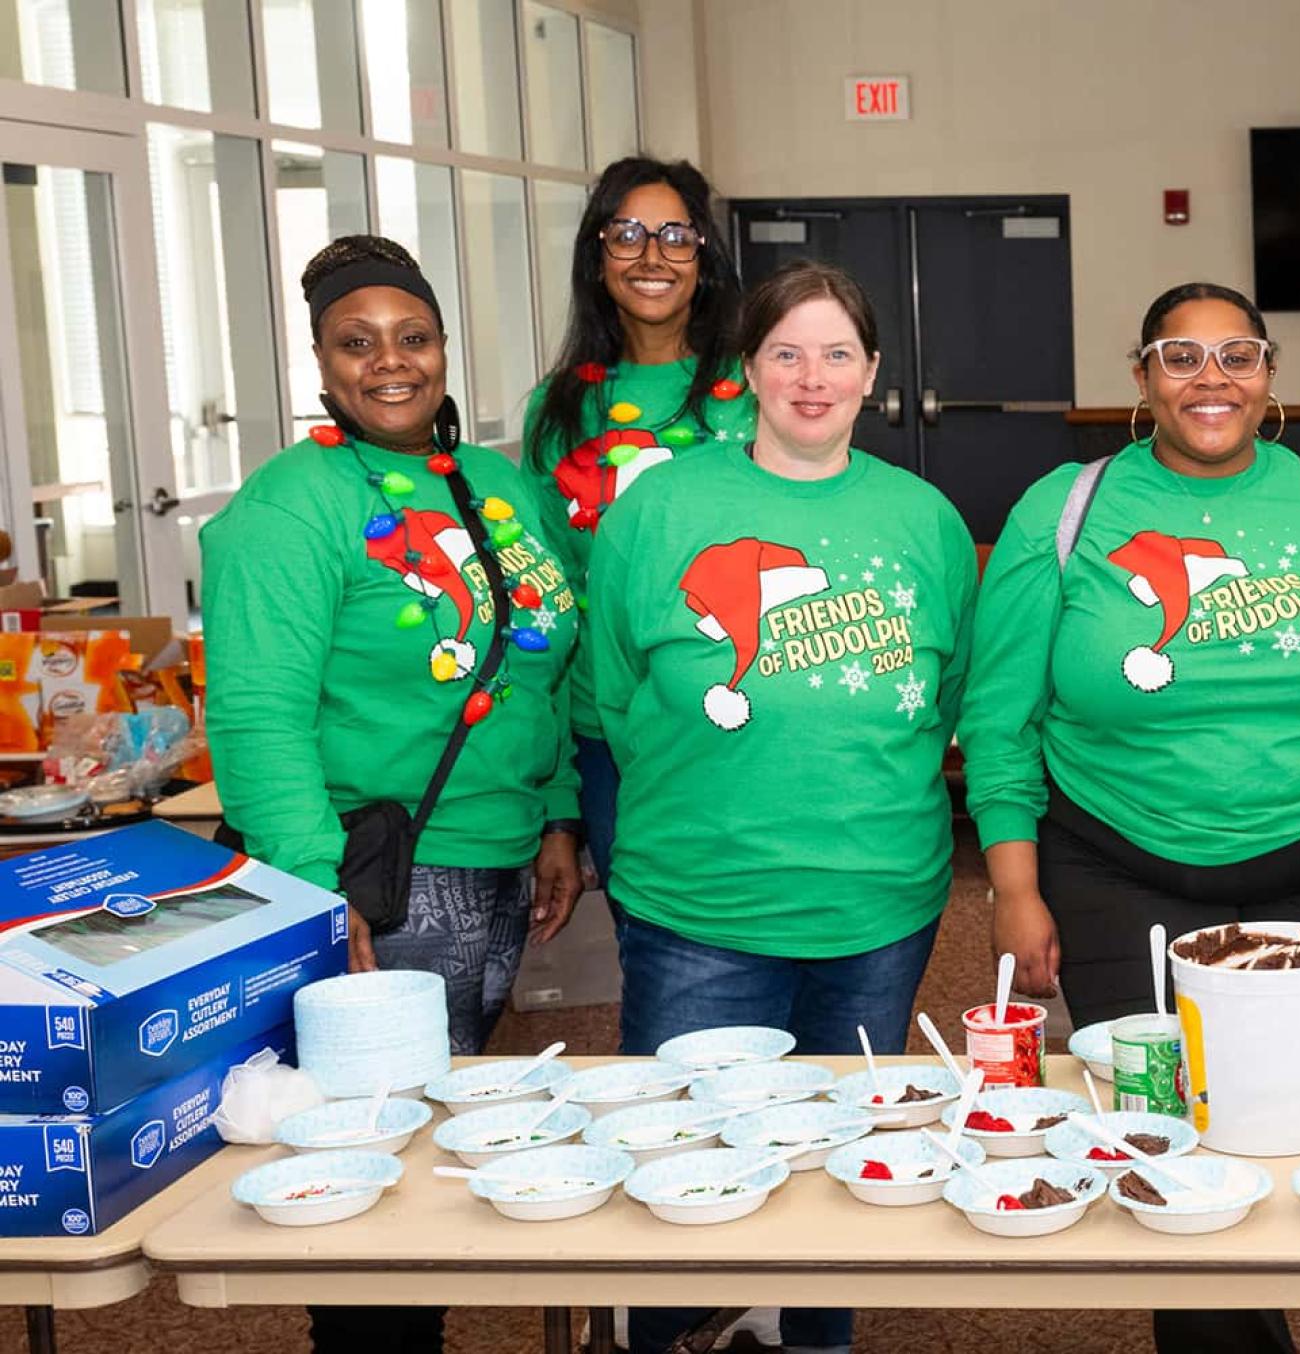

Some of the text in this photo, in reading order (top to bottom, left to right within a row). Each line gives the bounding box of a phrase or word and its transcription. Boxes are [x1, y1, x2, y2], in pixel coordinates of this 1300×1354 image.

[856, 82, 898, 114] EXIT
[462, 541, 536, 591] FRNDS
[766, 588, 885, 640] FRIENDS
[758, 615, 912, 677] OF RUDOLPH
[1186, 619, 1213, 643] OF
[871, 645, 914, 675] 2024
[188, 982, 232, 1012] EVERYDAY
[190, 997, 229, 1023] CUTLERY
[54, 1016, 76, 1032] 540
[182, 1006, 238, 1043] ASSORTMENT
[175, 1102, 208, 1132] CUTLERY
[53, 1138, 74, 1154] 540
[0, 1164, 24, 1179] AY
